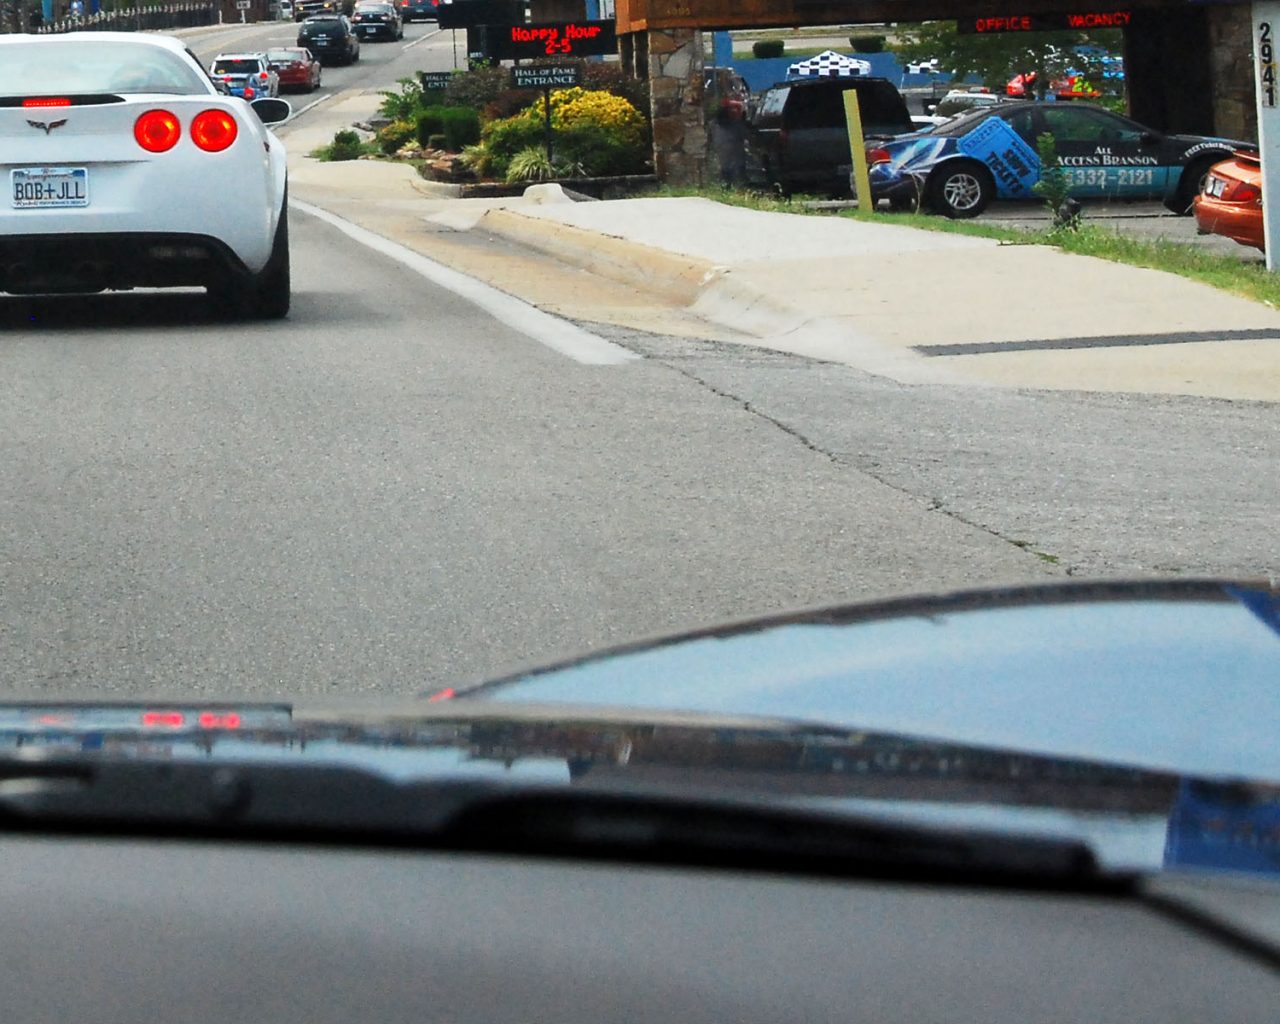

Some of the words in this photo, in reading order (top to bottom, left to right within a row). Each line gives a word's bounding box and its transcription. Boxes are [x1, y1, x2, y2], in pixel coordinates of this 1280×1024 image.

[976, 16, 1032, 33] OFFICE
[1068, 12, 1132, 28] VACANCY
[565, 23, 602, 39] Hour
[544, 38, 572, 55] 2-5
[515, 68, 538, 77] HALL
[552, 66, 577, 75] FAME
[1260, 22, 1276, 107] 2941
[517, 76, 576, 86] ENTRANCE
[1056, 155, 1100, 166] ACCESS
[1102, 154, 1158, 166] BRANSON
